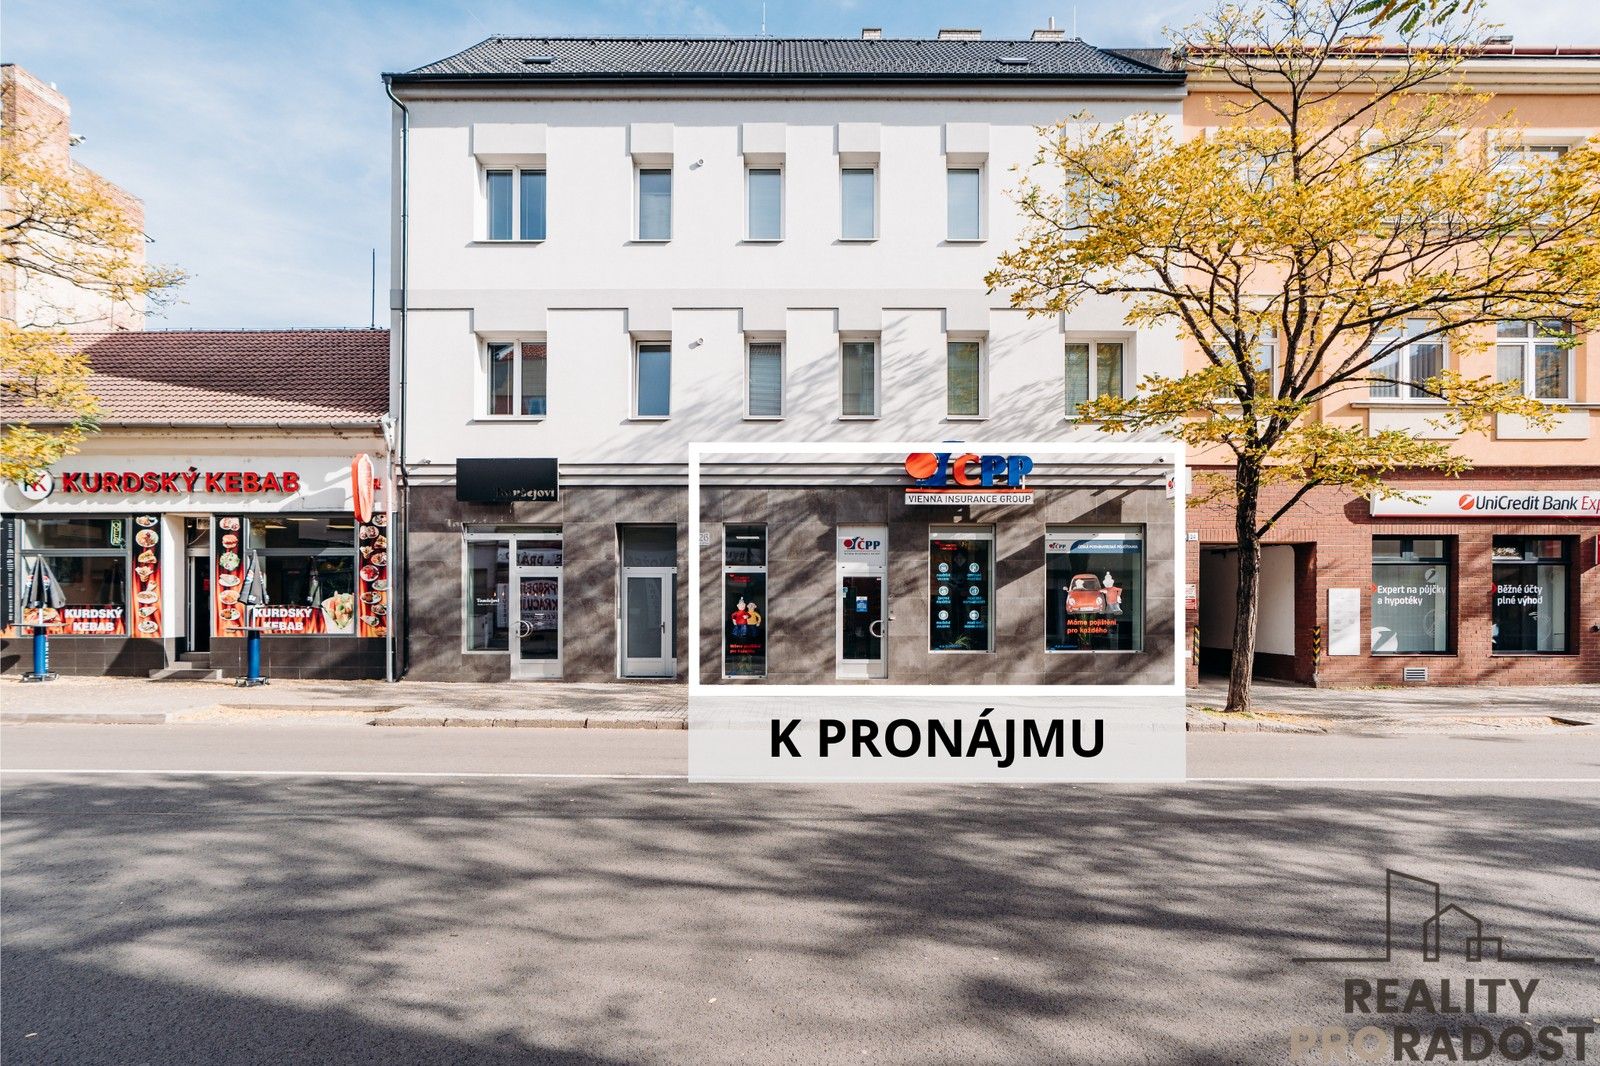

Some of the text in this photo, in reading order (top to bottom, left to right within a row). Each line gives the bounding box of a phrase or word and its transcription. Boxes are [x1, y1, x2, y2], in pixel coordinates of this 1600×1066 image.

[62, 466, 299, 493] KURDSKÝ KEBAB
[908, 495, 1031, 503] VIENNA INSURANCE GROUP
[1476, 495, 1539, 510] UniCredit
[1542, 495, 1578, 510] Bank
[857, 537, 880, 550] ČPP
[1377, 585, 1405, 595] Expert
[1419, 584, 1446, 595] půjčky
[1497, 584, 1543, 595] Běžné účty
[1377, 595, 1423, 606] a hypotéky
[1497, 595, 1543, 606] plné výhod
[64, 606, 123, 619] KURDSKÝ
[254, 606, 312, 618] KURDSKÝ
[72, 621, 115, 631] KEBAB
[263, 621, 304, 631] KEBAB
[1066, 618, 1088, 626] Máme
